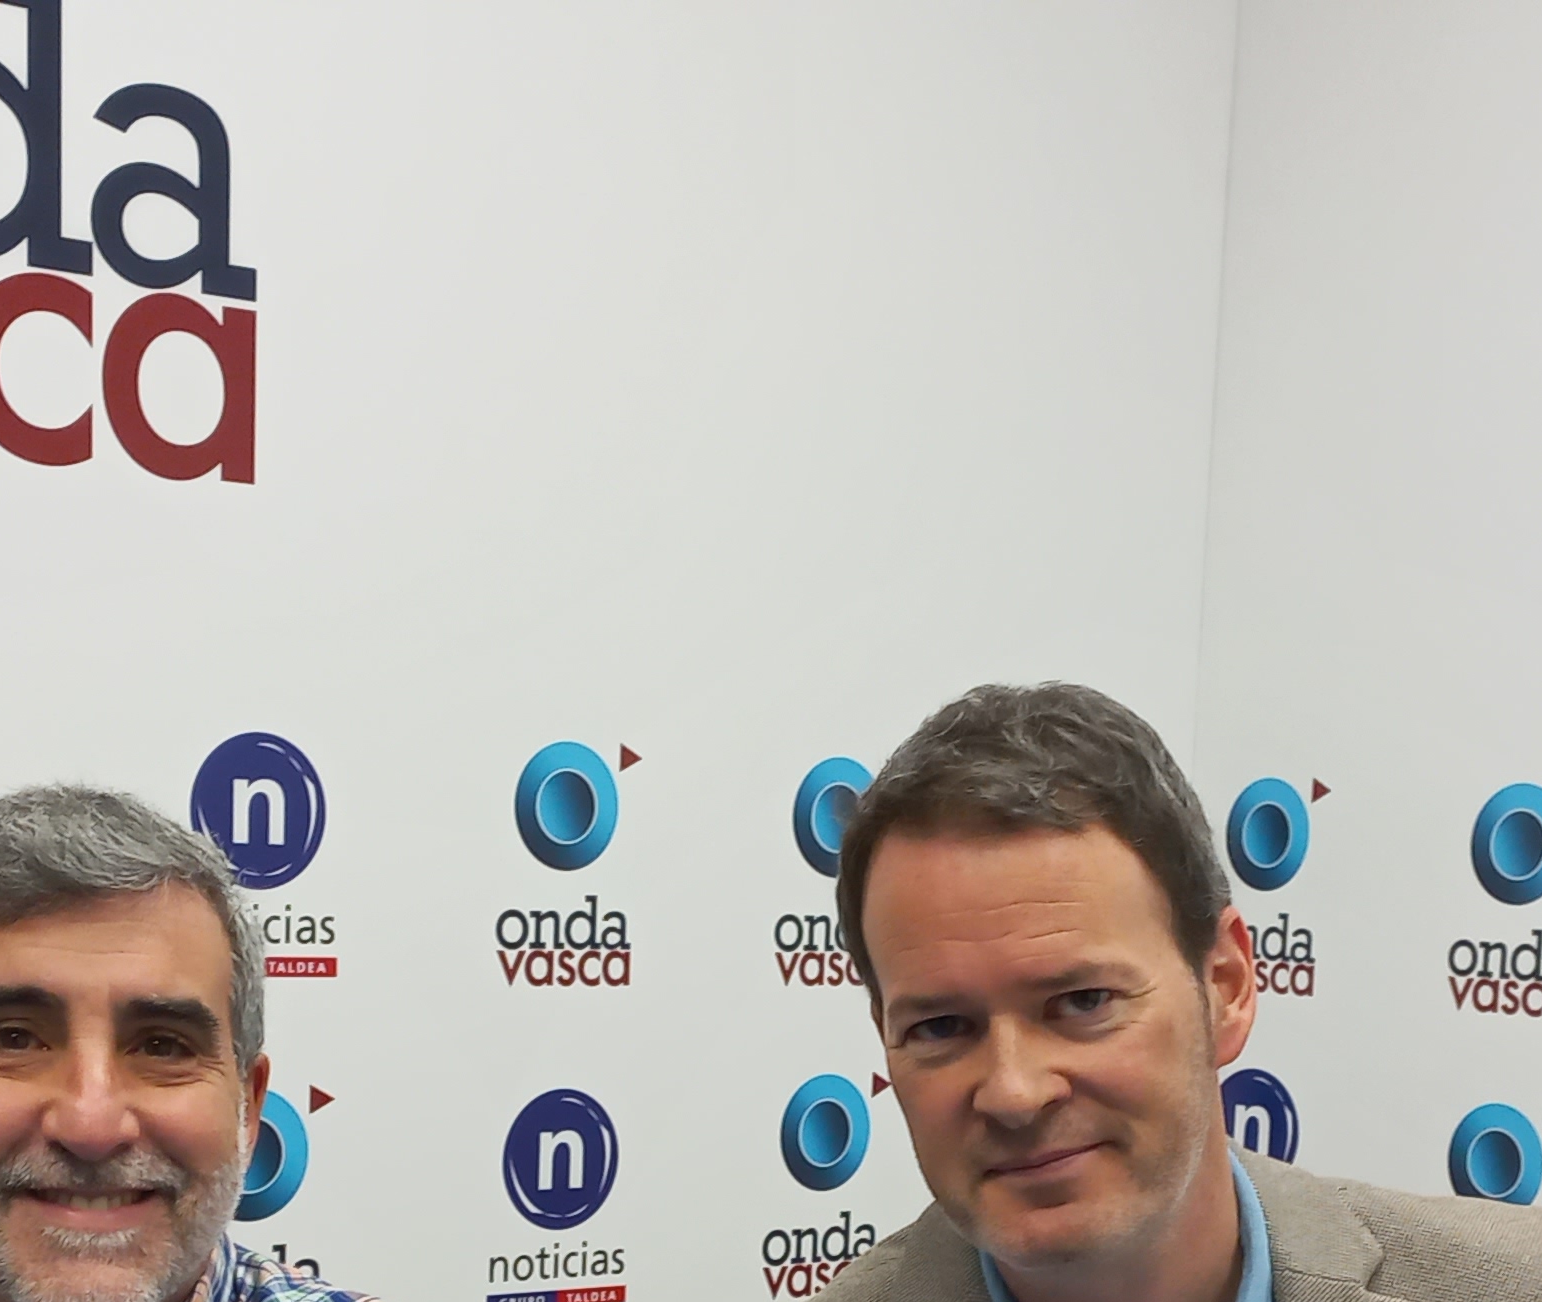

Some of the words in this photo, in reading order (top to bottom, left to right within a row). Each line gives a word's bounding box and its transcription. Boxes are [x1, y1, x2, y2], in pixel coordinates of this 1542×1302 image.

[231, 778, 287, 846] n
[495, 895, 631, 951] onda
[267, 961, 327, 974] TALDEA
[497, 946, 631, 988] vasca
[538, 1129, 585, 1192] n
[487, 1241, 627, 1284] noticias
